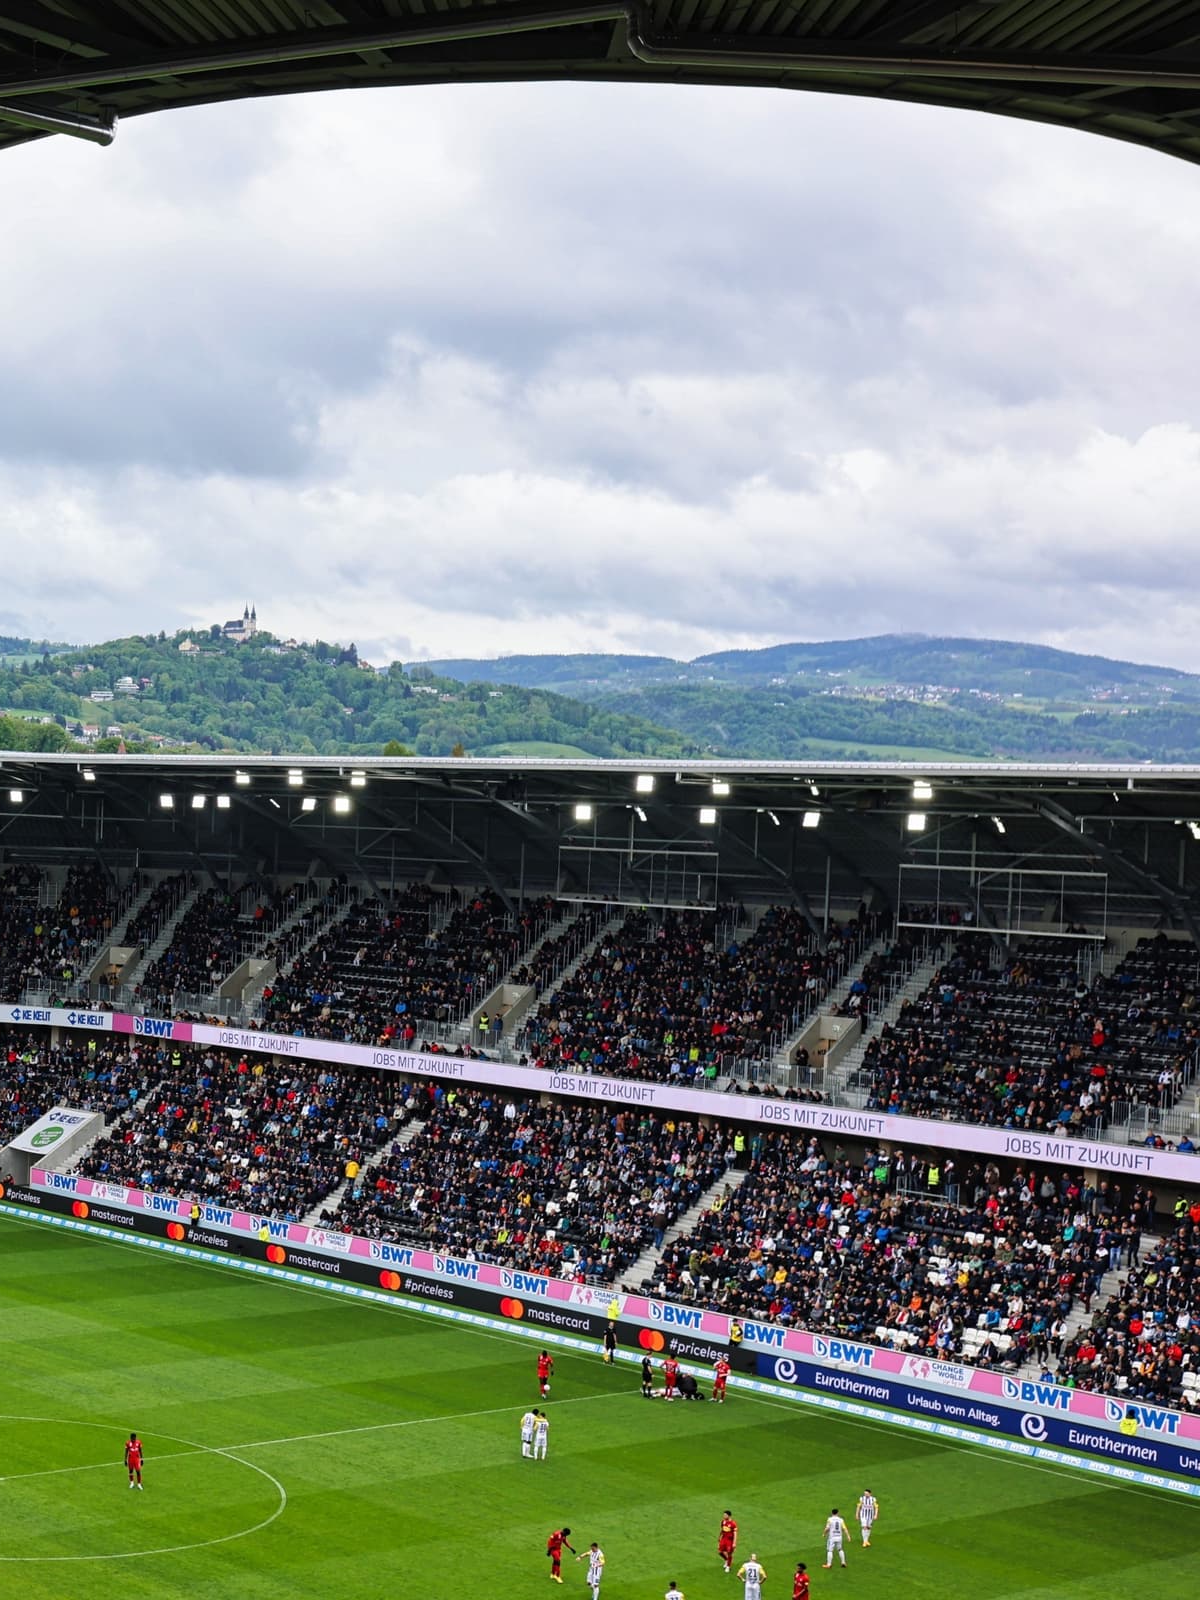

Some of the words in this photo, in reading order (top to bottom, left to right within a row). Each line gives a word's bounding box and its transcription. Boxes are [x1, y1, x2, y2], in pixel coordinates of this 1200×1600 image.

[22, 1010, 32, 1020] KE
[33, 1011, 51, 1022] KELIT
[78, 1014, 86, 1025] KE
[87, 1015, 104, 1026] KELIT
[144, 1018, 172, 1037] BWT
[219, 1031, 239, 1044] JOBS
[241, 1034, 258, 1046] MIT
[259, 1037, 300, 1053] ZUKUNFT
[373, 1052, 395, 1066] JOBS
[398, 1056, 416, 1068] MIT
[418, 1058, 464, 1076] ZUKUNFT
[549, 1076, 575, 1090] JOBS
[578, 1080, 599, 1093] MIT
[601, 1083, 656, 1102] ZUKUNFT
[760, 1104, 790, 1120] JOBS
[794, 1109, 818, 1124] MIT
[821, 1113, 885, 1134] ZUKUNFT
[1005, 1138, 1041, 1155] JOBS
[1046, 1143, 1074, 1160] MIT
[1078, 1147, 1154, 1170] ZUKUNFT
[54, 1175, 77, 1191] BWT
[7, 1188, 41, 1204] #priceless
[154, 1197, 178, 1214] BWT
[92, 1208, 134, 1226] mastercard
[206, 1208, 232, 1225] BWT
[188, 1230, 228, 1247] #priceless
[289, 1253, 340, 1273] mastercard
[382, 1246, 412, 1265] BWT
[446, 1260, 478, 1280] BWT
[405, 1279, 454, 1299] #priceless
[513, 1274, 548, 1295] BWT
[528, 1308, 590, 1330] mastercard
[664, 1306, 702, 1328] BWT
[744, 1323, 785, 1346] BWT
[669, 1338, 729, 1362] #priceless
[830, 1342, 874, 1366] BWT
[932, 1363, 964, 1374] CHANGE
[938, 1371, 964, 1381] WORLD
[815, 1372, 890, 1400] Eurothermen
[1021, 1382, 1071, 1409] BWT
[908, 1394, 941, 1411] Urlaub
[944, 1404, 965, 1417] vom
[968, 1408, 1000, 1426] Alltag.
[914, 1420, 932, 1430] HYPO
[940, 1425, 958, 1436] HYPO
[962, 1431, 980, 1441] HYPO
[988, 1437, 1006, 1448] HYPO
[1011, 1443, 1030, 1454] HYPO
[1069, 1430, 1157, 1461] Eurothermen
[1040, 1449, 1058, 1460] HYPO
[1062, 1455, 1081, 1466] HYPO
[1090, 1461, 1110, 1472] HYPO
[1114, 1467, 1135, 1478] HYPO
[1144, 1473, 1164, 1485] HYPO
[1168, 1479, 1189, 1491] HYPO
[748, 1568, 757, 1578] 21
